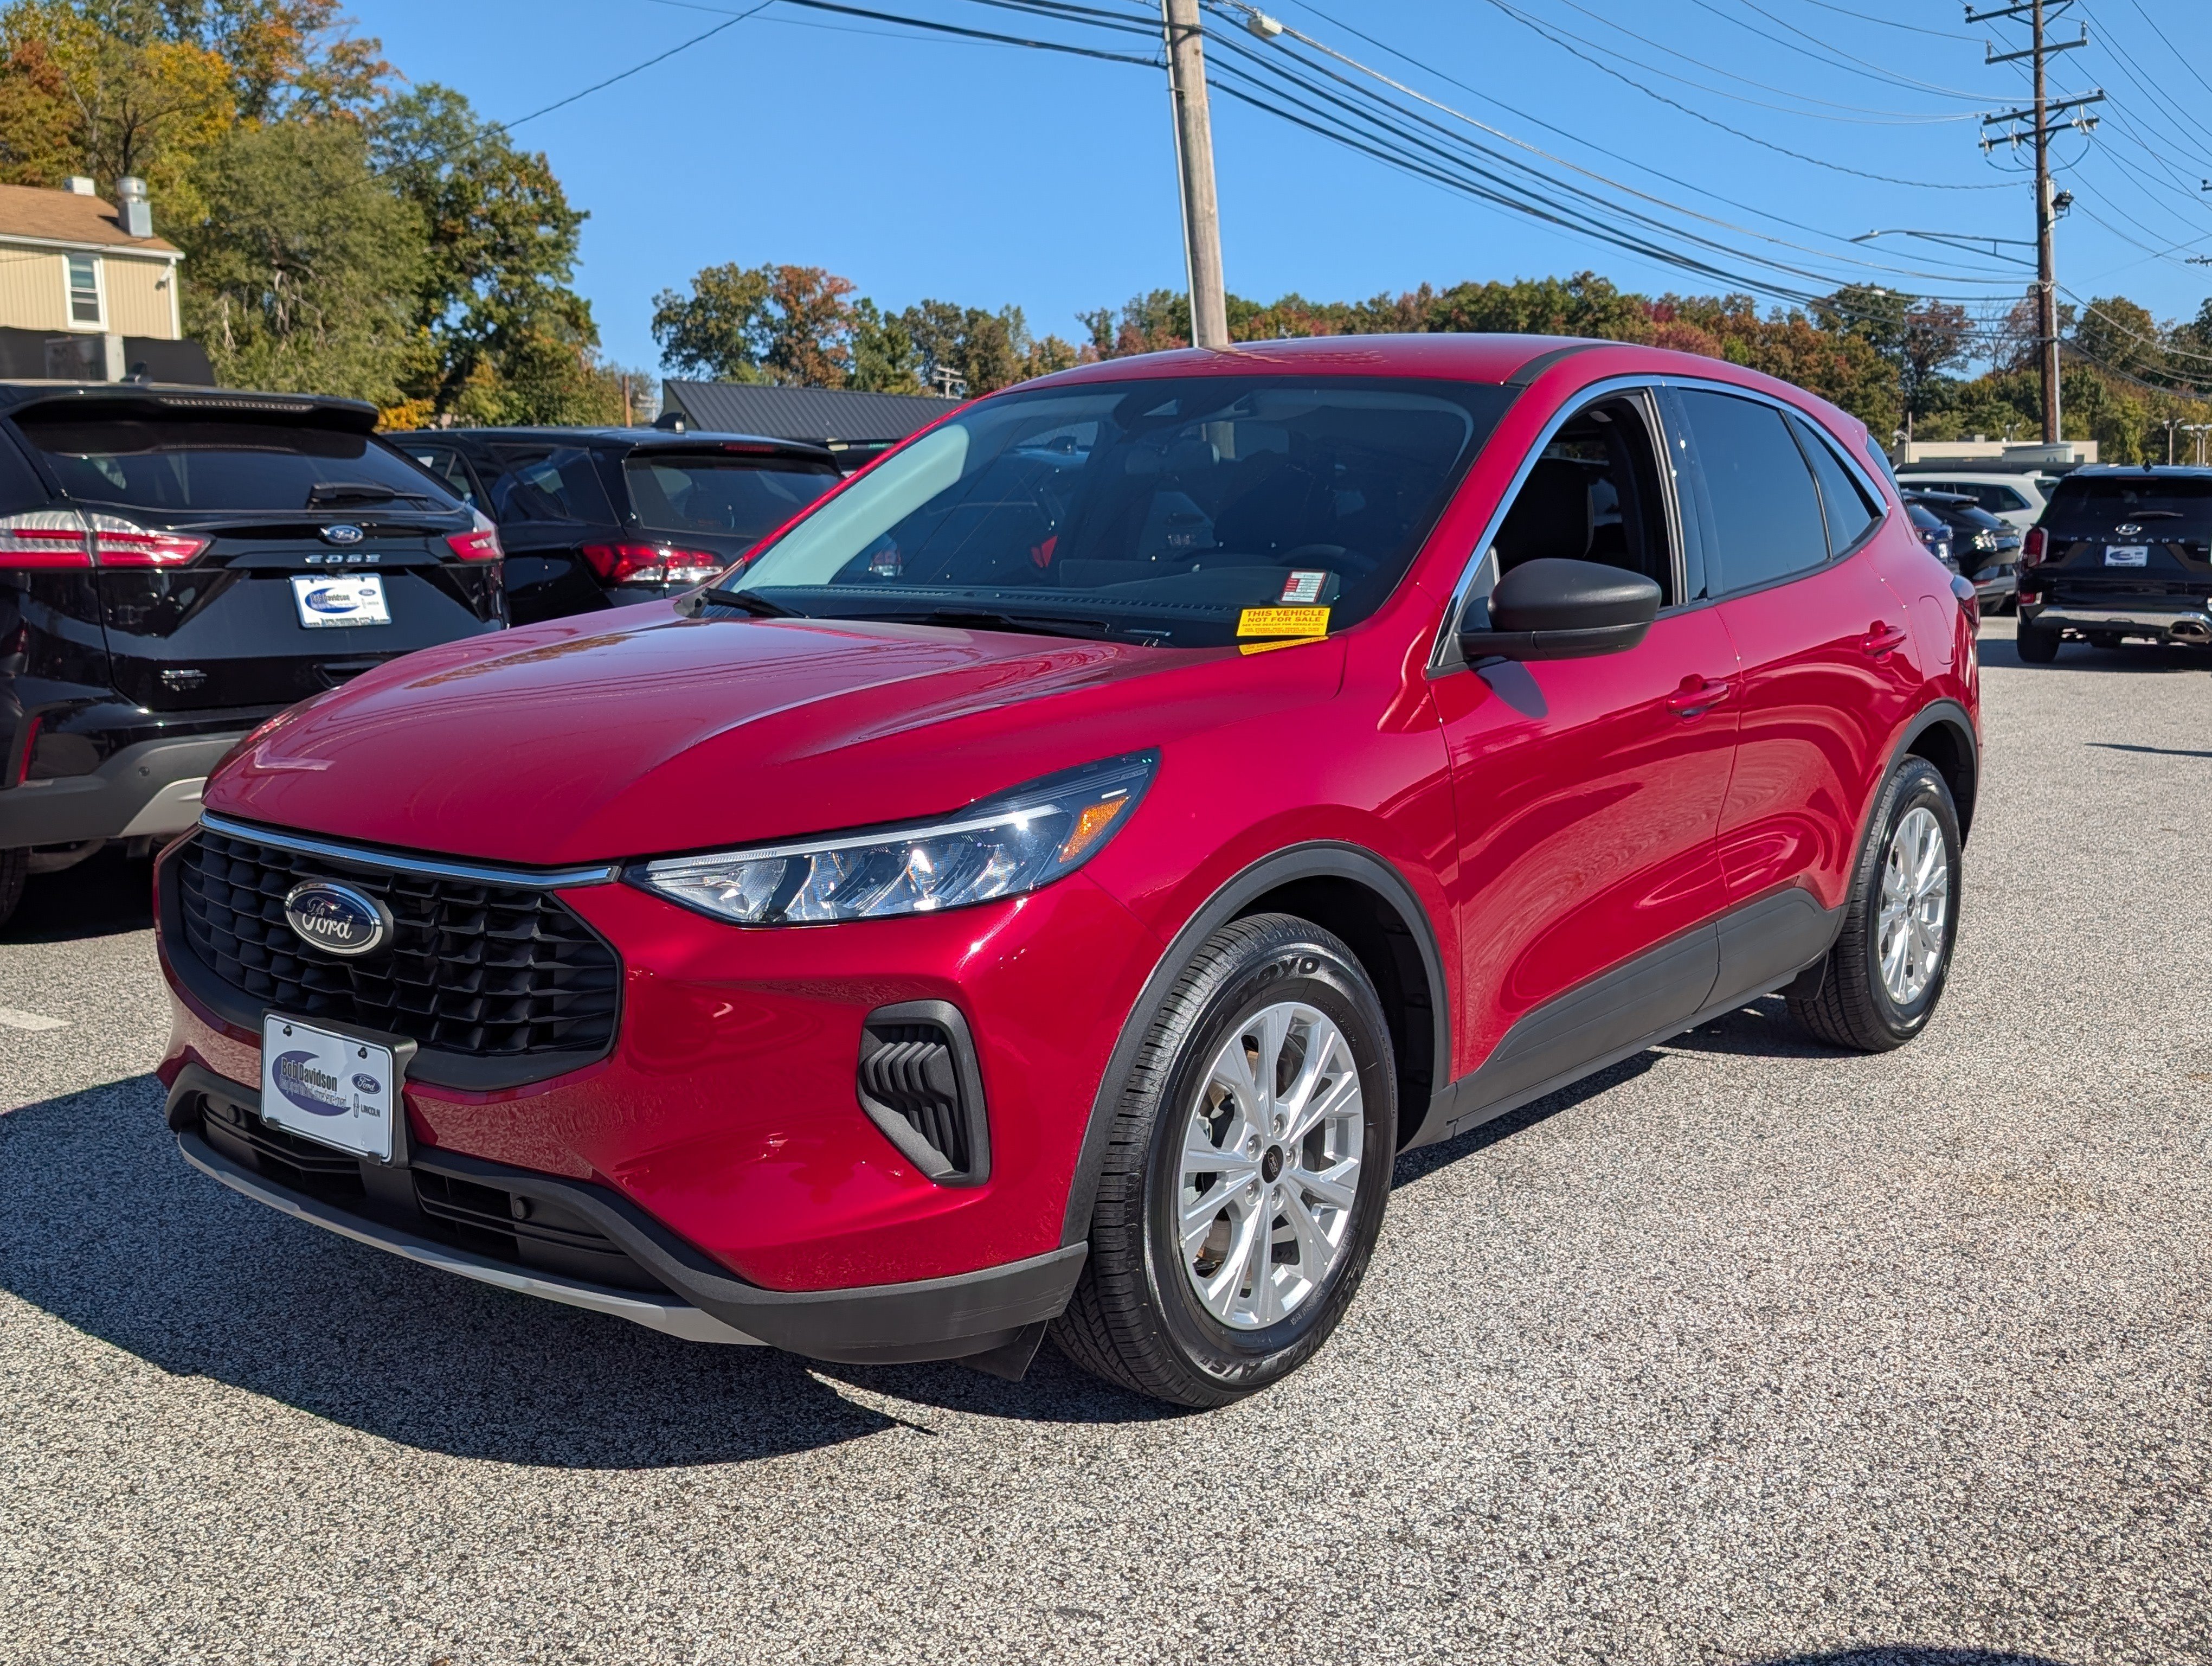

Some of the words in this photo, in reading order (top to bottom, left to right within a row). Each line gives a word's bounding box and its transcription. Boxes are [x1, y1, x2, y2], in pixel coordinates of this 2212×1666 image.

[305, 554, 381, 563] EDGE
[302, 896, 354, 939] Ford
[1234, 957, 1320, 1004] TOYO
[281, 1058, 298, 1079] Bob
[299, 1063, 337, 1092] Davidson
[357, 1077, 375, 1091] Ford
[361, 1104, 381, 1118] LINCOLN
